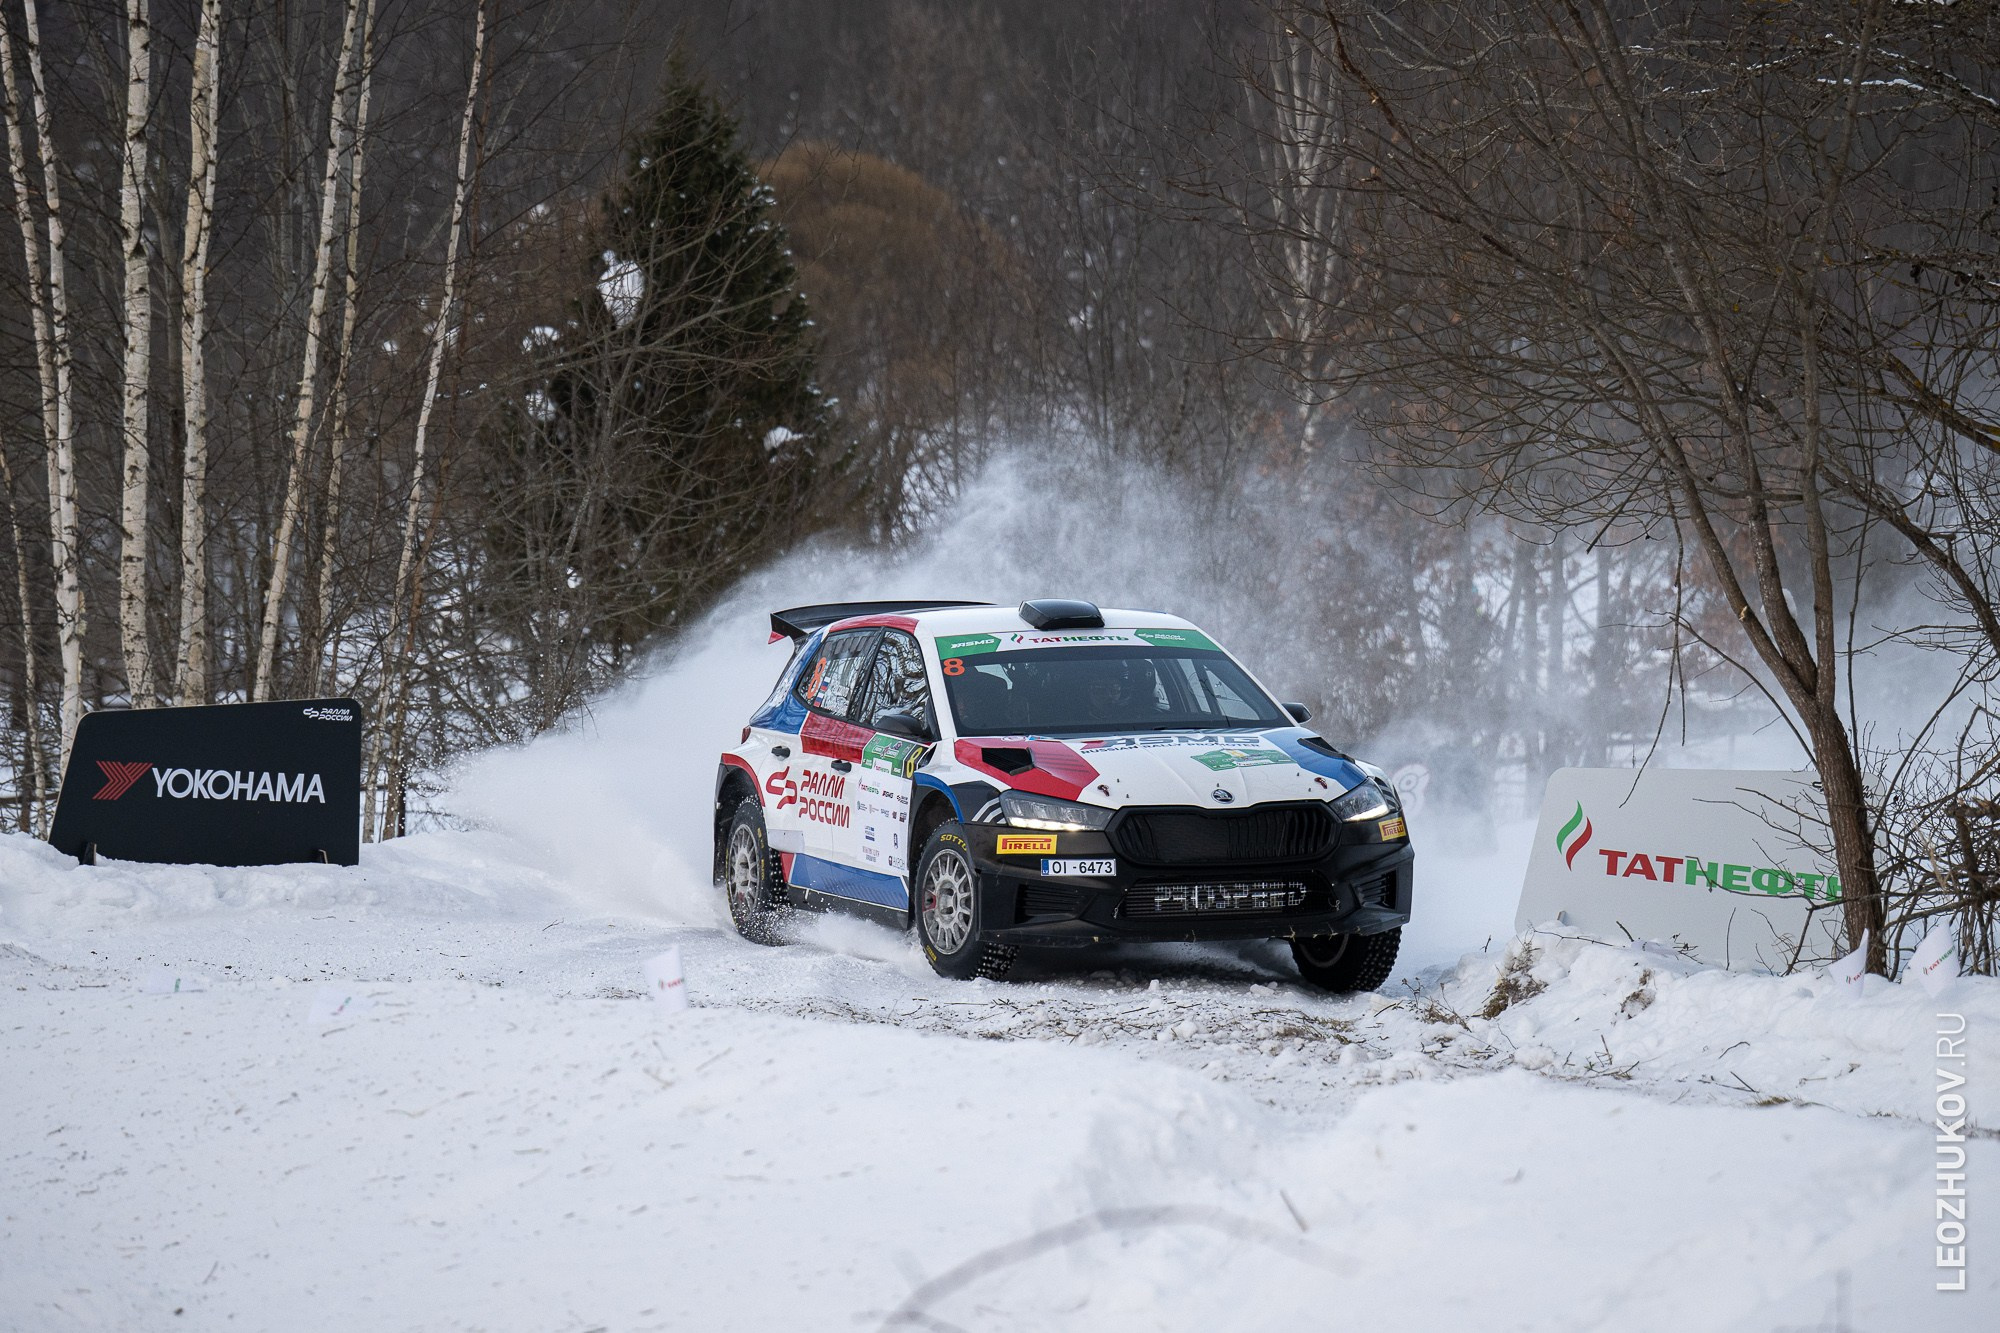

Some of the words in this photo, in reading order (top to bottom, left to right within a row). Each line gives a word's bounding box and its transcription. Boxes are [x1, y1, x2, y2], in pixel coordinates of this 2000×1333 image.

[1028, 634, 1129, 644] ТАТНЕФТЬ
[943, 658, 965, 676] 8
[807, 657, 827, 699] 8
[317, 714, 353, 722] РОССИИ
[320, 707, 350, 715] РАЛЛИ
[1101, 735, 1260, 747] ASMG
[1080, 745, 1139, 755] RUSSIAN
[906, 746, 923, 779] 8
[152, 767, 326, 804] YOKOHAMA
[800, 769, 846, 800] РАЛЛИ
[798, 796, 850, 829] РОССИИ
[1382, 820, 1404, 837] PIRELLI
[1001, 838, 1052, 850] PIRELLI
